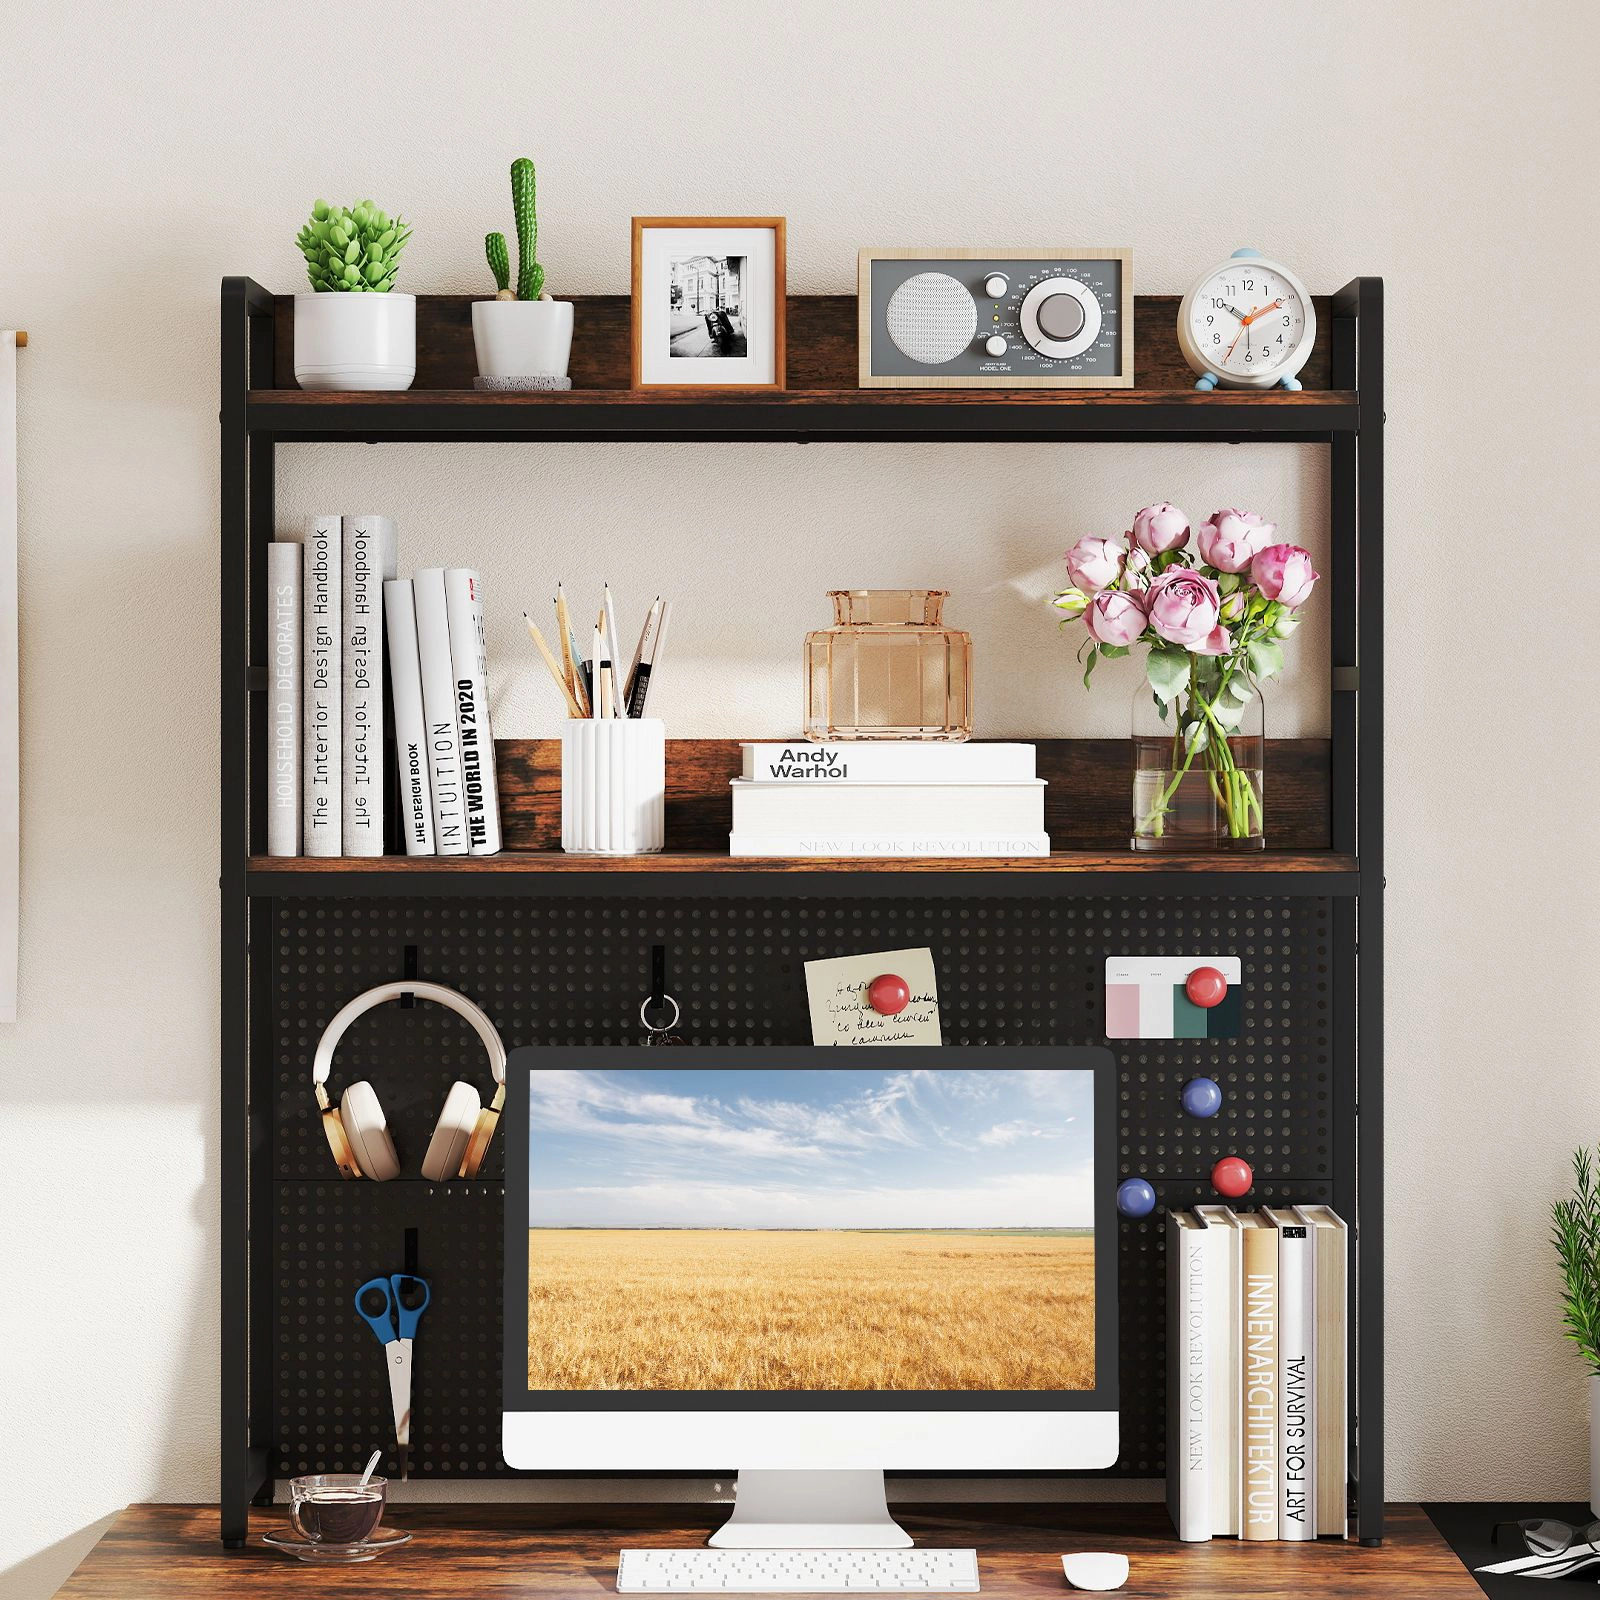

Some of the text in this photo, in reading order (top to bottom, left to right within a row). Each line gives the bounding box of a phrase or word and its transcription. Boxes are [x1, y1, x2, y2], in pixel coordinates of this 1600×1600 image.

[1226, 286, 1236, 296] 11
[1242, 280, 1253, 291] 12
[1264, 286, 1268, 296] 1
[1211, 298, 1224, 308] 10
[1207, 316, 1214, 326] 9
[1283, 316, 1290, 326] 3
[1213, 333, 1220, 344] 8
[1276, 334, 1283, 344] 4
[1245, 351, 1252, 362] 6
[1262, 346, 1270, 357] 5
[312, 528, 332, 828] The Interior Design Handbook
[276, 585, 293, 808] HOUSEHOLD DECORATES
[779, 748, 839, 766] Andy
[457, 679, 487, 848] THE WORLD IN 2020
[769, 764, 848, 778] Warhol
[432, 722, 461, 847] INTUITION
[799, 841, 1041, 852] NEW LOOK REVOLUTION
[1189, 1246, 1203, 1471] NEW LOOK REVOLUTION
[1247, 1274, 1275, 1524] INNENARCHITEKTUR
[1286, 1355, 1306, 1522] ART FOR SURVIVAL
